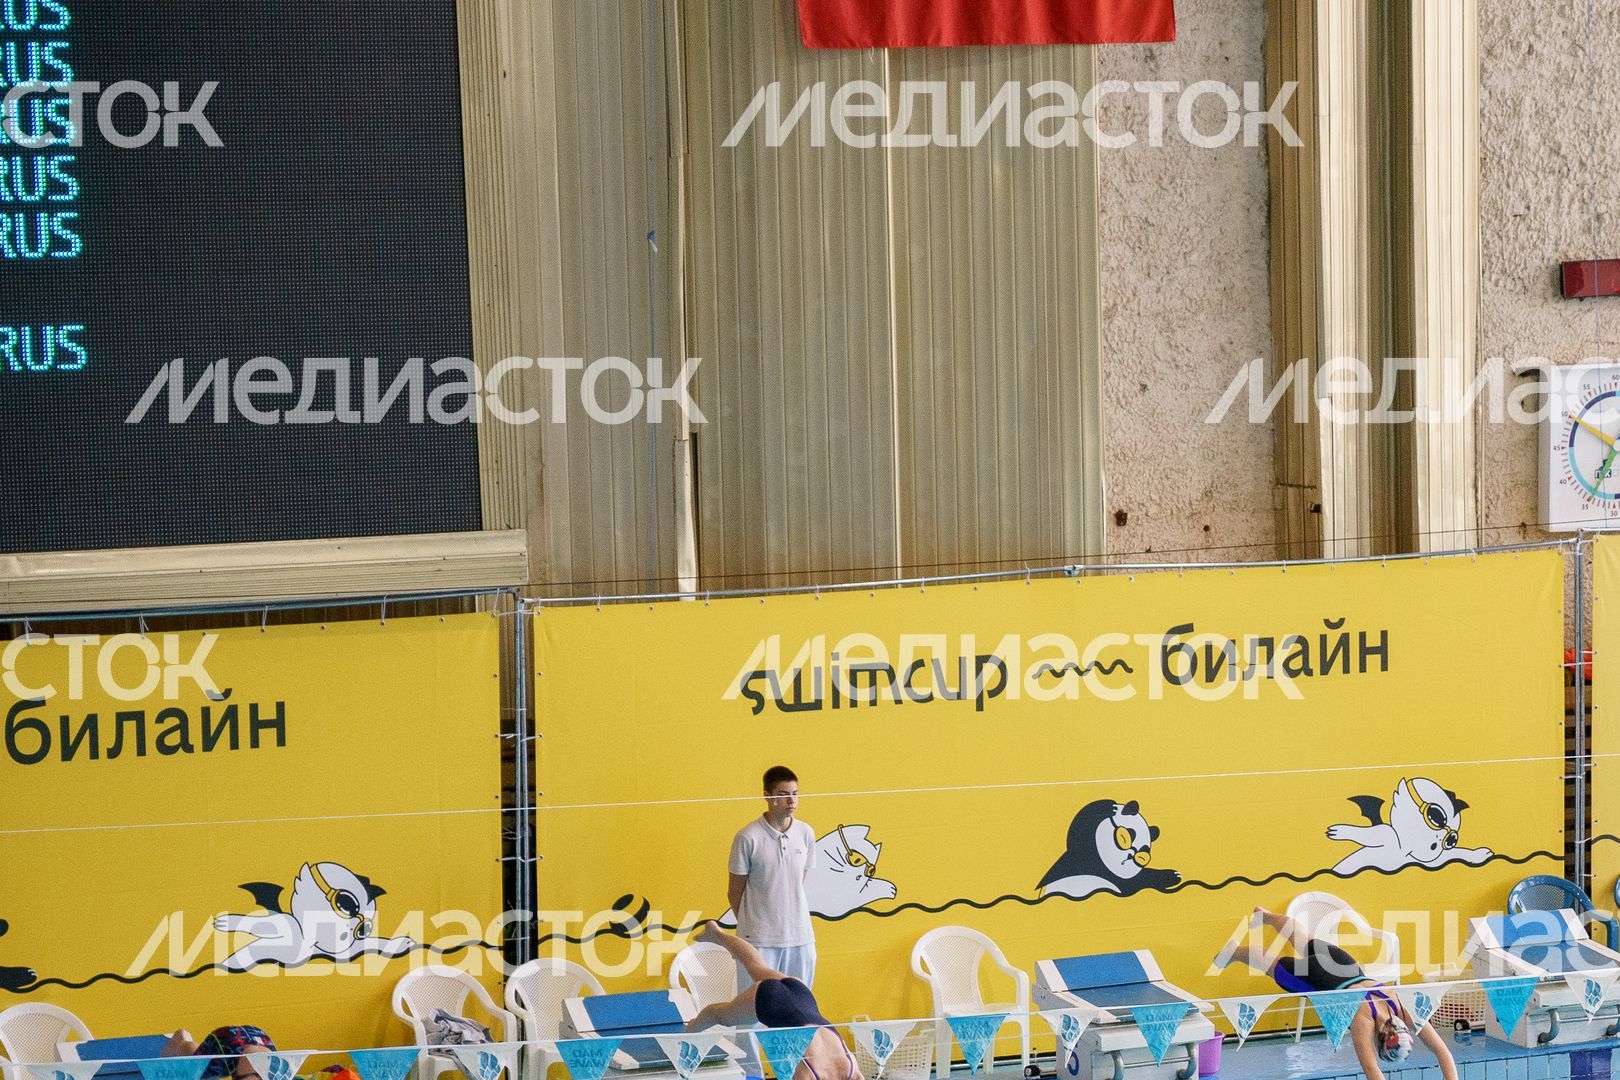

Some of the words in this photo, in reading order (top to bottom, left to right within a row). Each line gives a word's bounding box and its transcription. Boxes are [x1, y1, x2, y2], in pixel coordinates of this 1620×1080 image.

[0, 42, 74, 88] US
[0, 325, 88, 371] RUS
[739, 651, 1009, 715] swimcup
[1161, 617, 1390, 686] билайн
[5, 688, 286, 766] билайн
